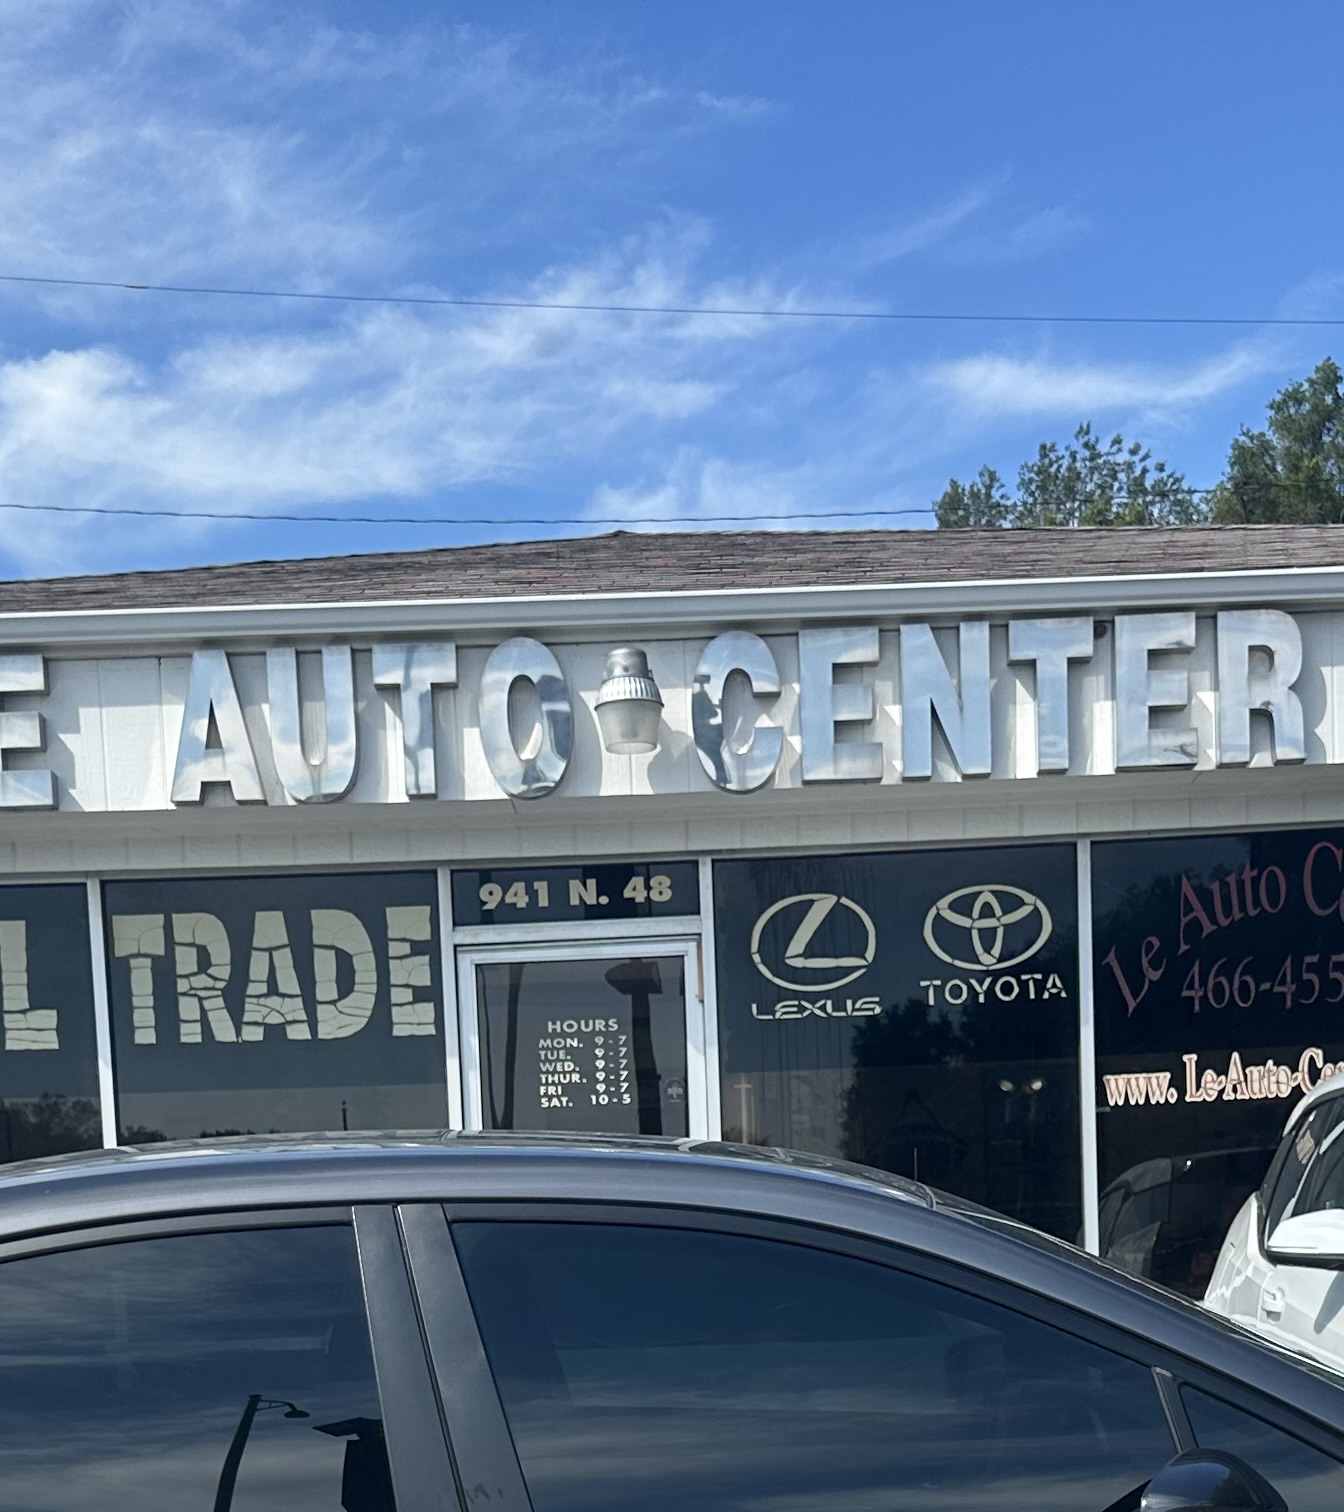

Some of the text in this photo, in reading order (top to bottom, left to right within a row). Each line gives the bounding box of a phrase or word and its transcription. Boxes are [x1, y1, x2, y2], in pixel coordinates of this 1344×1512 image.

[172, 637, 575, 805] AUTO
[692, 608, 1306, 794] CENTER
[479, 875, 672, 910] 941 N. 48
[1102, 935, 1167, 1018] Le
[1177, 864, 1286, 956] Auto
[111, 904, 437, 1047] TRADE
[919, 973, 1067, 1006] TOYOTA
[751, 996, 883, 1020] LEXUS
[547, 1018, 619, 1033] HOURS
[538, 1037, 583, 1048] MON.
[538, 1049, 571, 1060] TUE.
[539, 1061, 580, 1072] WED.
[539, 1073, 587, 1084] THUR.
[539, 1085, 562, 1096] FRI
[541, 1096, 573, 1108] SAT.
